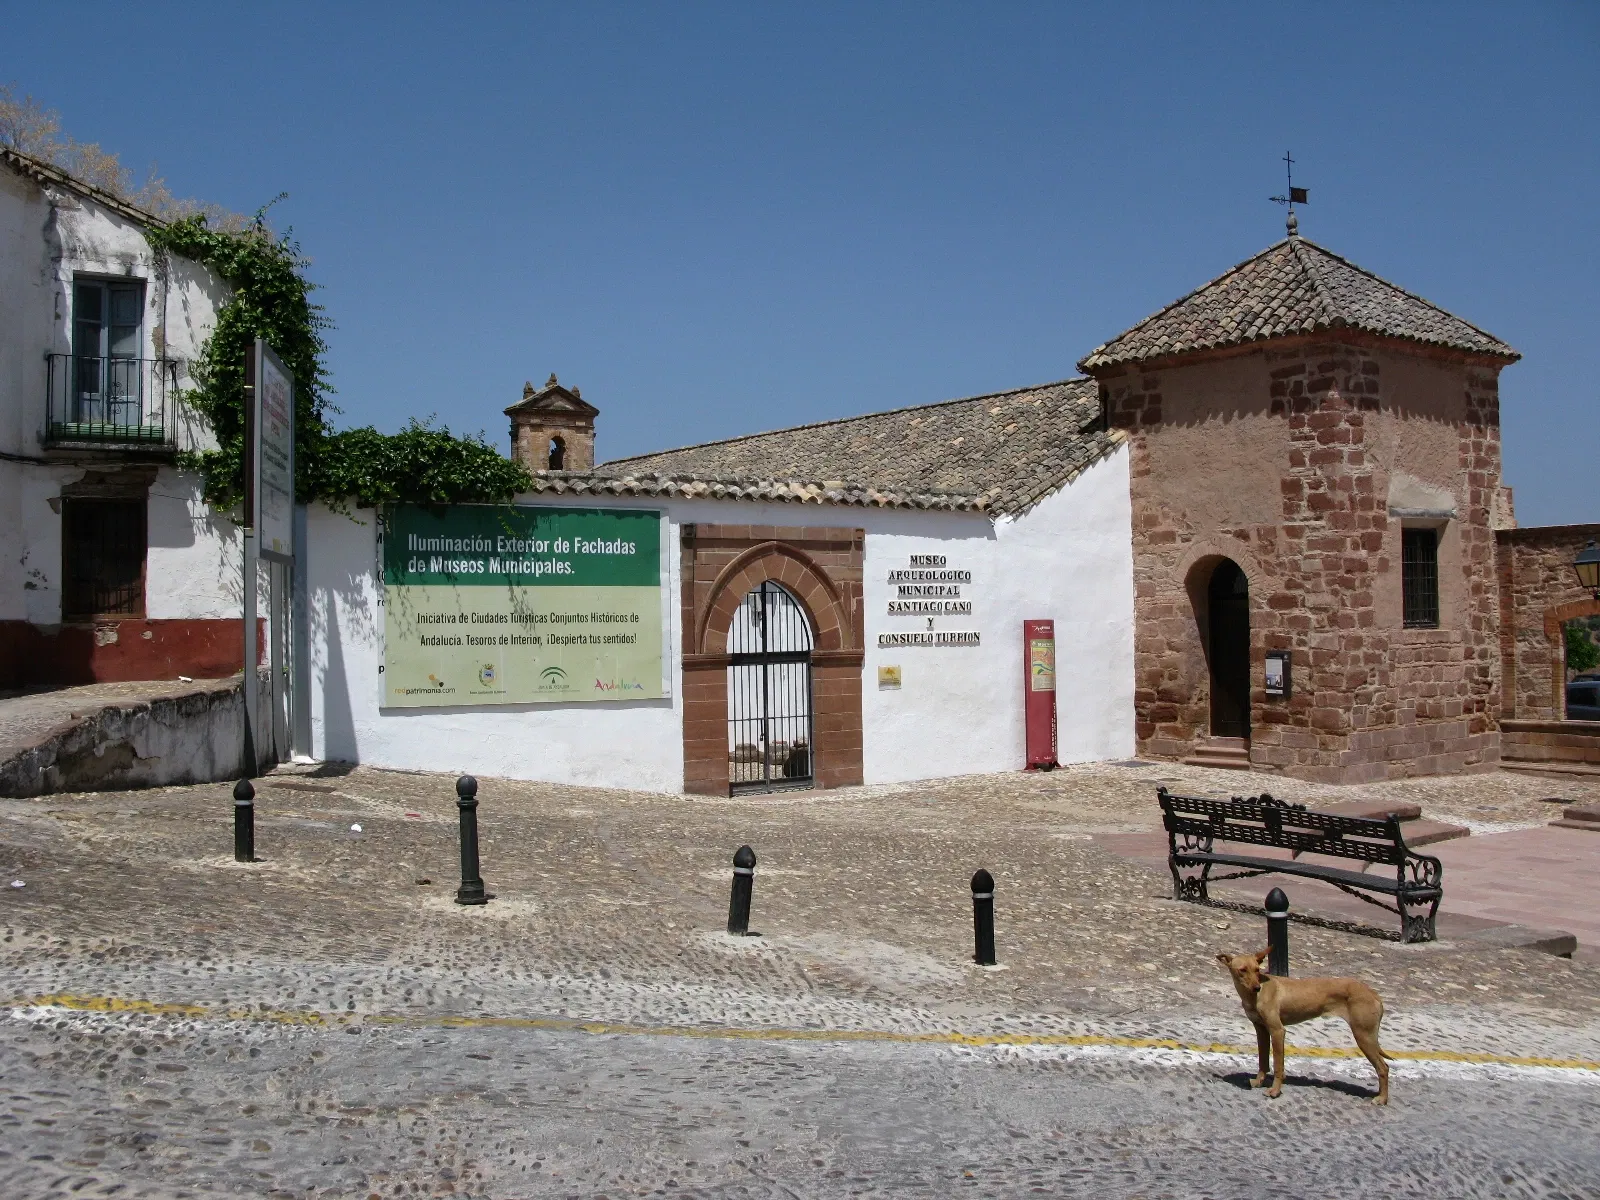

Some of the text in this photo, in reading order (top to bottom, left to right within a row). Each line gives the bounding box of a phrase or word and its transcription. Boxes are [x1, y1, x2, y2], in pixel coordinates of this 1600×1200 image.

[408, 533, 636, 555] Iluminación Exterior de Fachadas
[910, 555, 947, 566] MUSEO
[408, 556, 575, 577] de Museos Municipales.
[888, 570, 972, 581] ARQUEOLOGICO
[898, 585, 960, 596] MUNICIPAL
[888, 601, 972, 612] SANTIAGO CANO
[417, 612, 456, 624] Iniciativa
[459, 613, 469, 624] de
[471, 612, 508, 624] Ciudades
[550, 612, 589, 625] Conjuntos
[590, 612, 628, 623] Históricos
[630, 612, 639, 623] de
[927, 617, 934, 627] Y
[420, 634, 464, 646] Andalucía.
[466, 634, 497, 646] Tesoros
[498, 634, 509, 645] de
[511, 634, 543, 646] Interior,
[589, 633, 601, 644] tus
[603, 633, 637, 644] sentidos!
[878, 632, 981, 644] CONSUELO TURRION
